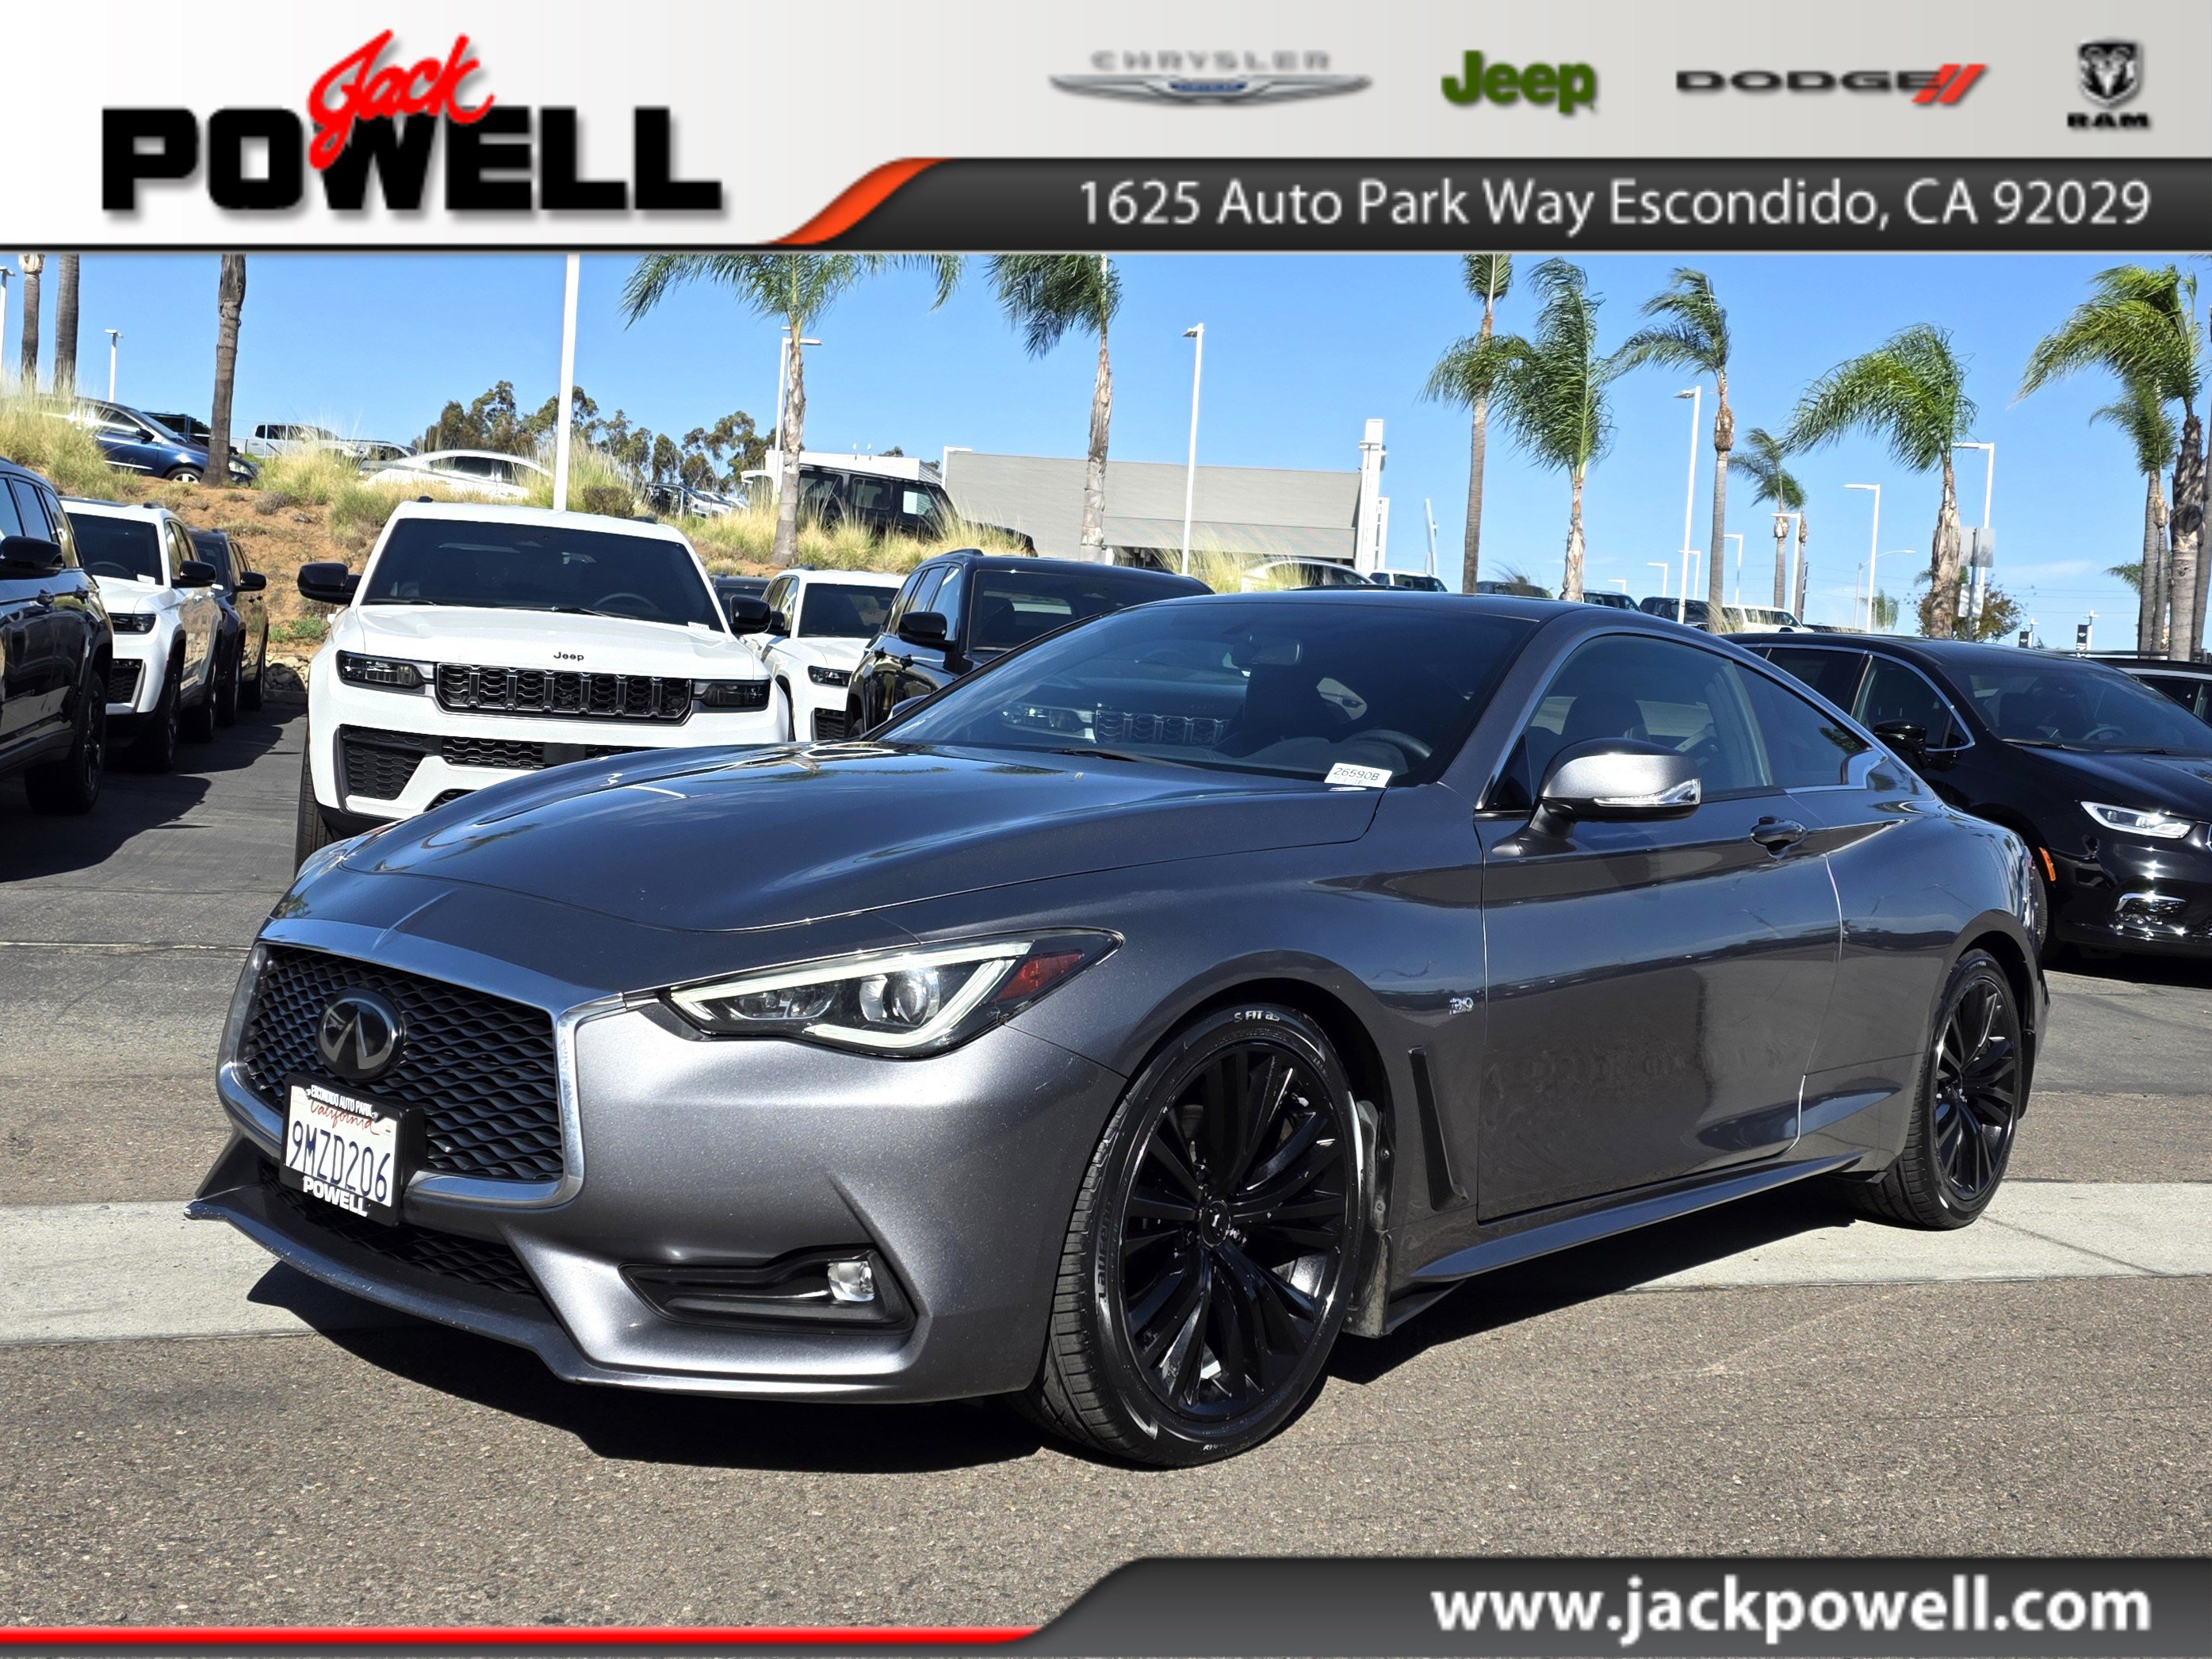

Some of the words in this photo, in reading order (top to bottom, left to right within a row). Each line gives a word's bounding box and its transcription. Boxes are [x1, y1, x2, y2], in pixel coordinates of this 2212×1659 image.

[553, 652, 584, 662] Jeep
[310, 1099, 381, 1136] California
[339, 1096, 355, 1112] AUTO
[355, 1100, 373, 1118] PARK
[289, 1120, 392, 1203] 9MZD206
[303, 1175, 369, 1217] POWELL
